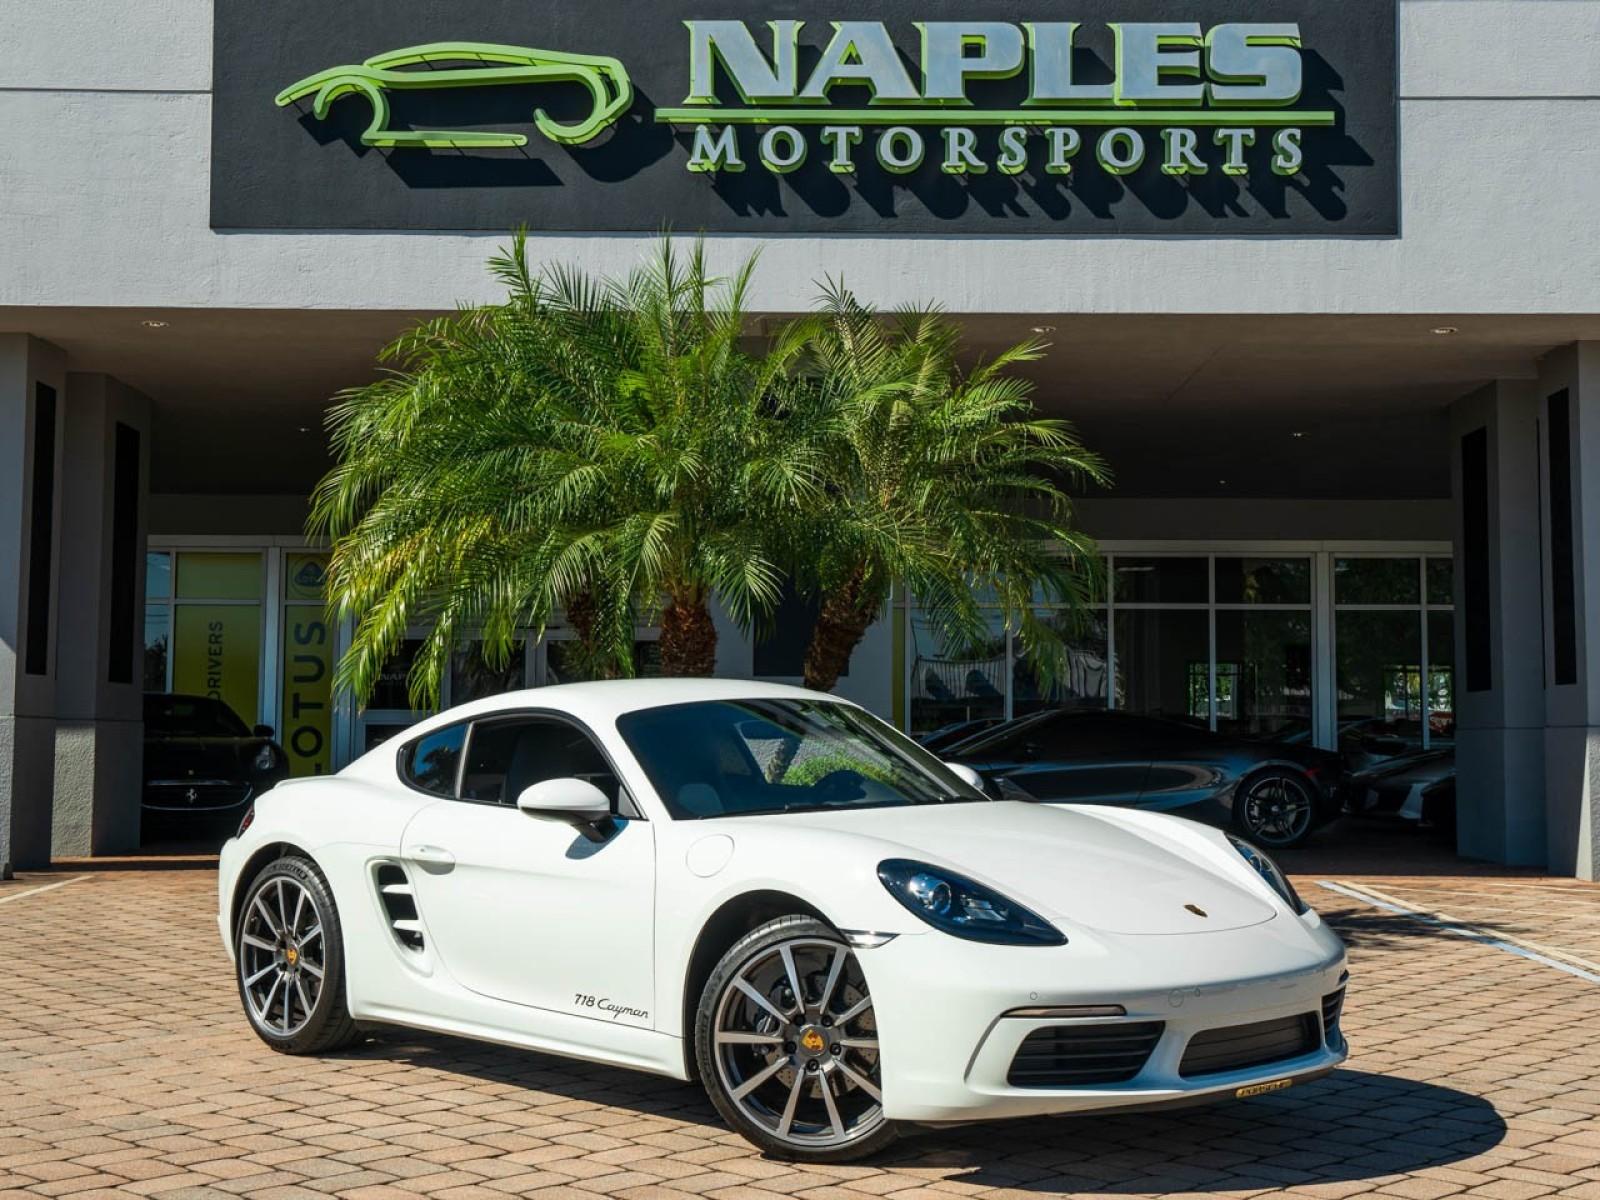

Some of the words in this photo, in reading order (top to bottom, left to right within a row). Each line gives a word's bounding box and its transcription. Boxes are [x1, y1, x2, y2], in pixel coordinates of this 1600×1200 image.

[682, 19, 1302, 106] NAPLES
[686, 124, 1303, 175] MOTORSPORTS
[574, 993, 595, 1007] 718
[597, 998, 648, 1019] Cayman
